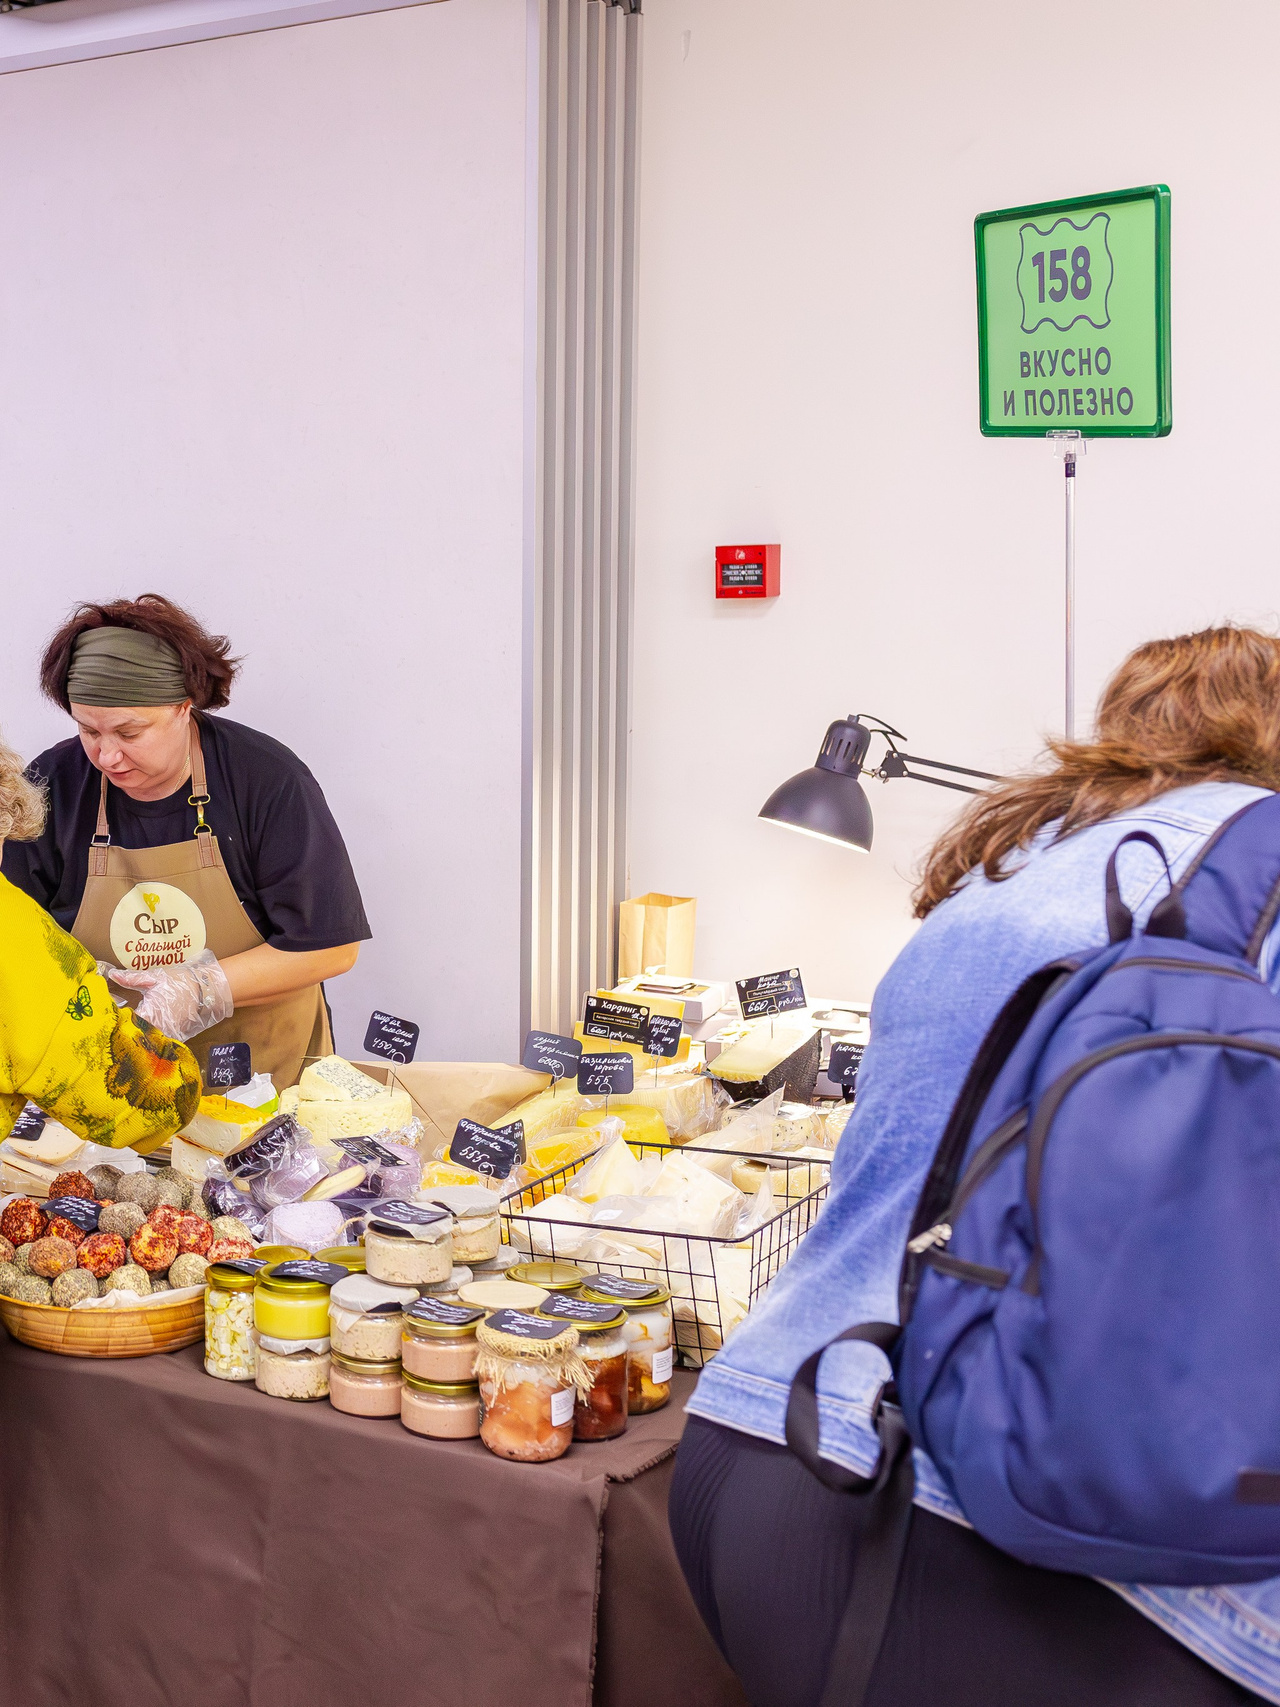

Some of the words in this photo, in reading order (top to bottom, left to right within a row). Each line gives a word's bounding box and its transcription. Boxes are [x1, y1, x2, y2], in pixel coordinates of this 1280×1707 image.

[1031, 245, 1092, 303] 158
[1020, 346, 1111, 378] ВКУСНО
[1003, 390, 1016, 417] И
[1024, 387, 1134, 416] ПОЛЕЗНО
[135, 935, 192, 953] большой
[131, 950, 186, 971] душой
[601, 1000, 638, 1014] Хардинг
